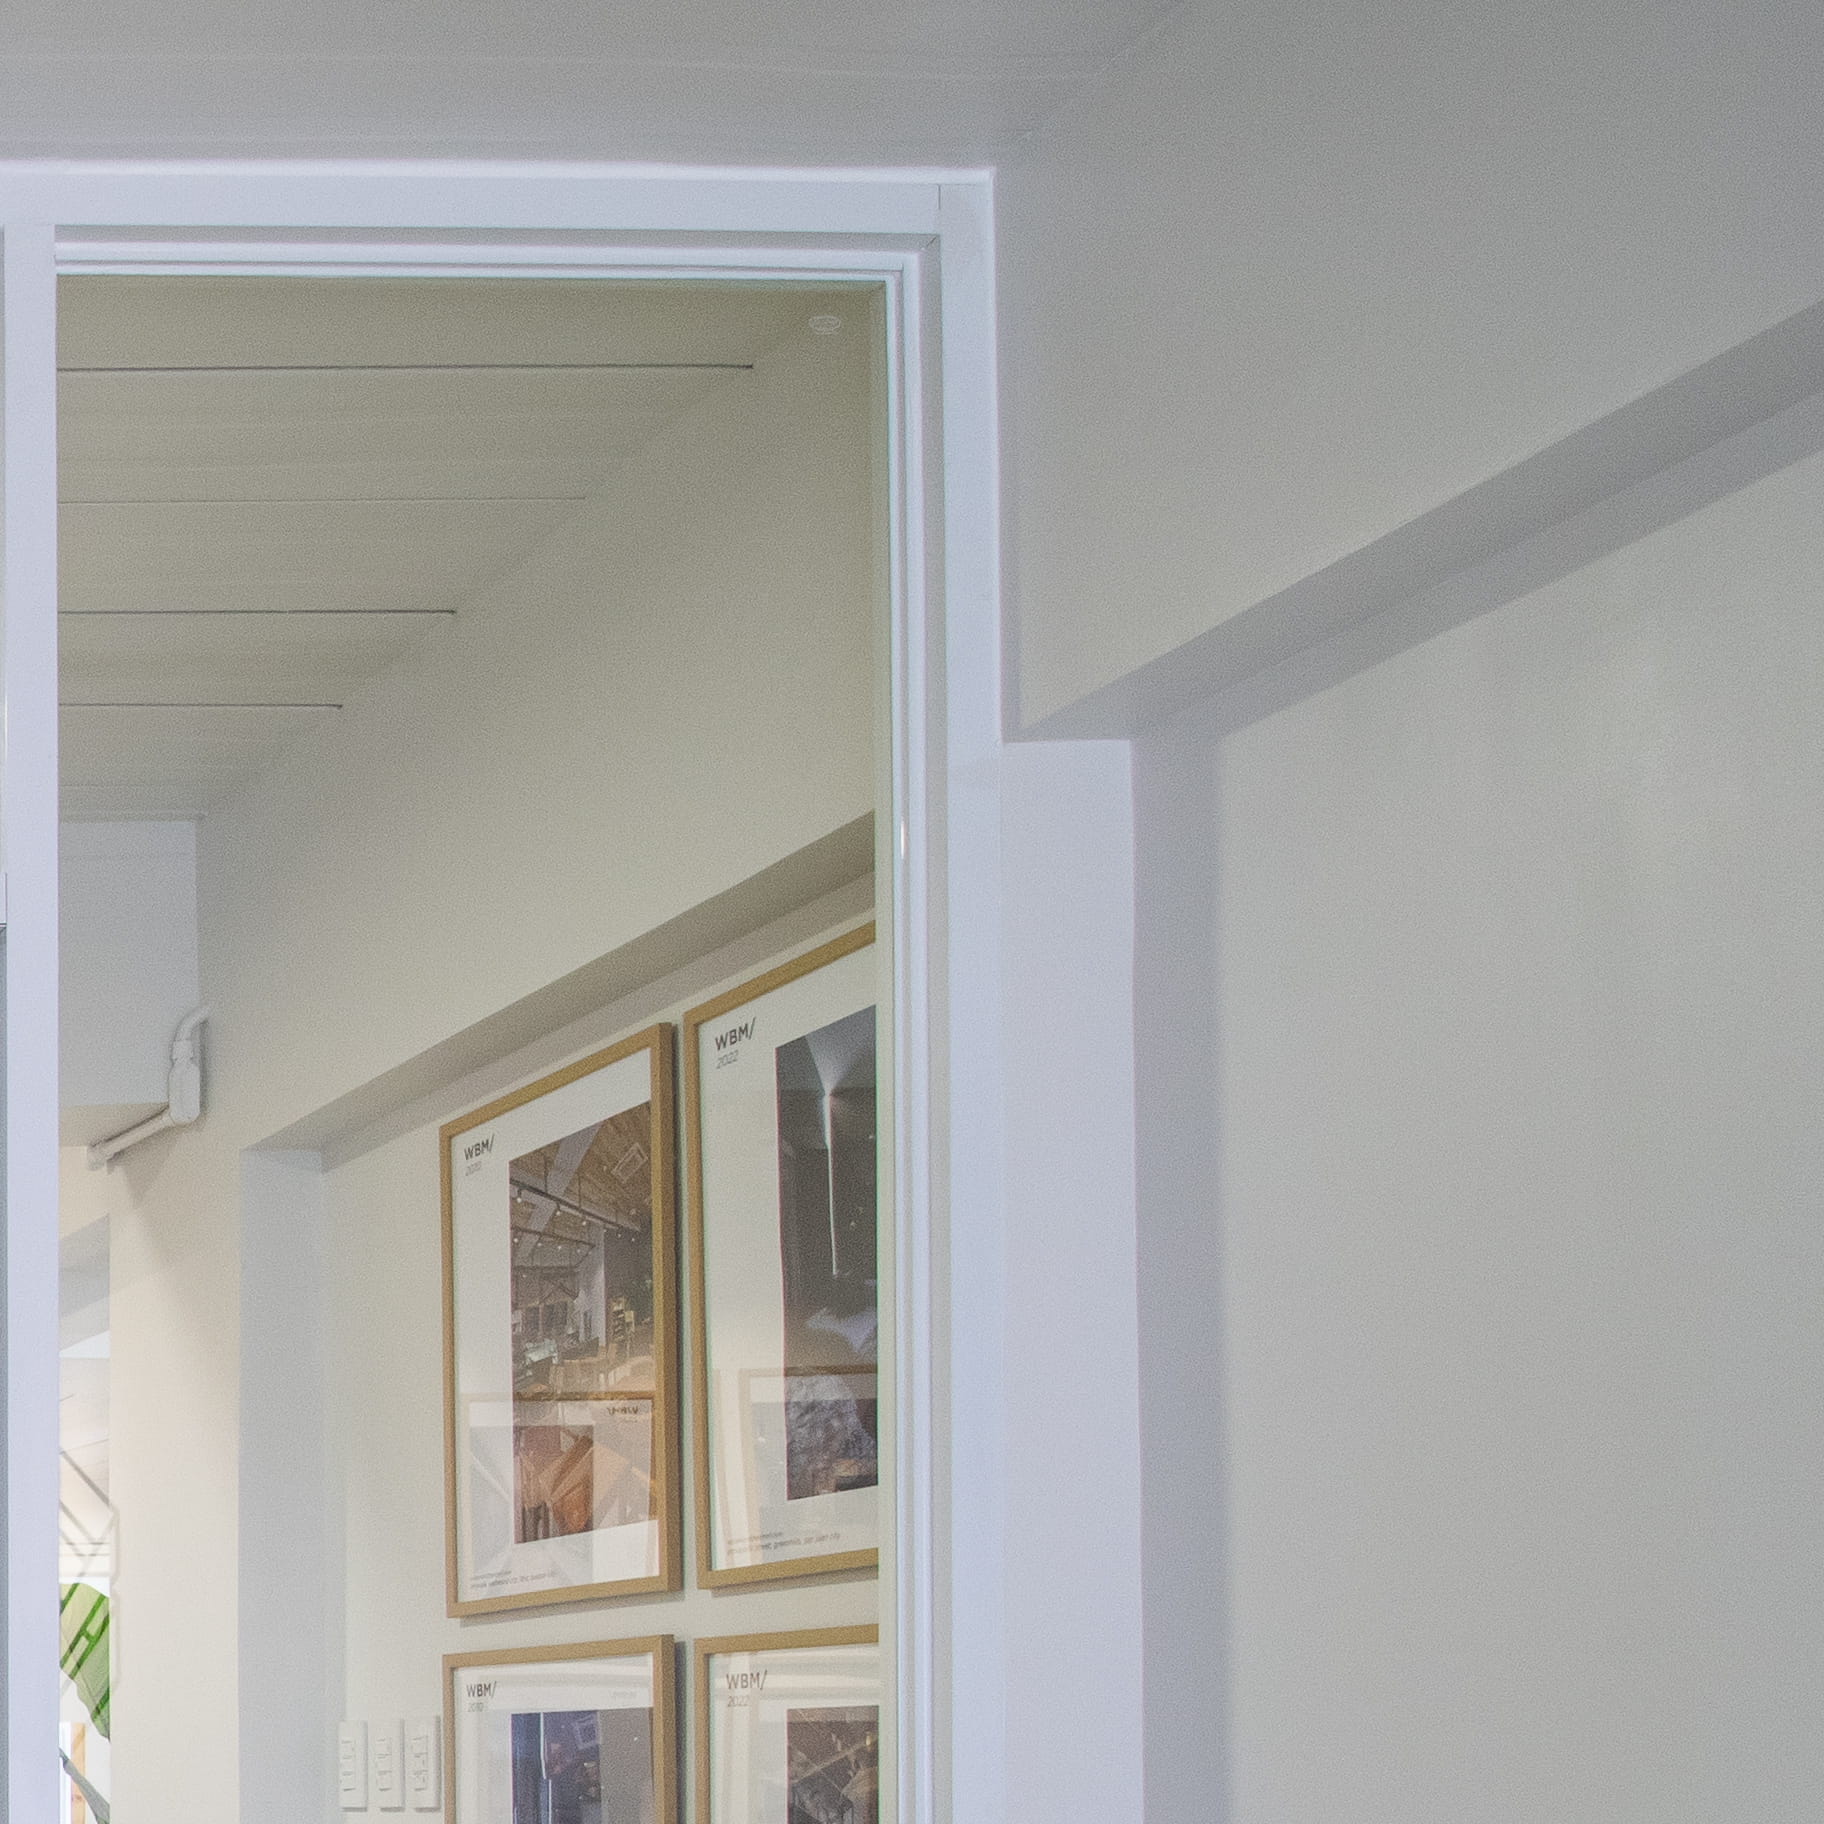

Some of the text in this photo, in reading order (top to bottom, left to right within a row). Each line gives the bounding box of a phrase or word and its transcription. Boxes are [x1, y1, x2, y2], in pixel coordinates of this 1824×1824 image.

[715, 1016, 756, 1051] WBM/
[464, 1133, 495, 1160] WBM/
[466, 1680, 497, 1698] WBM/
[726, 1669, 768, 1690] WBM/
